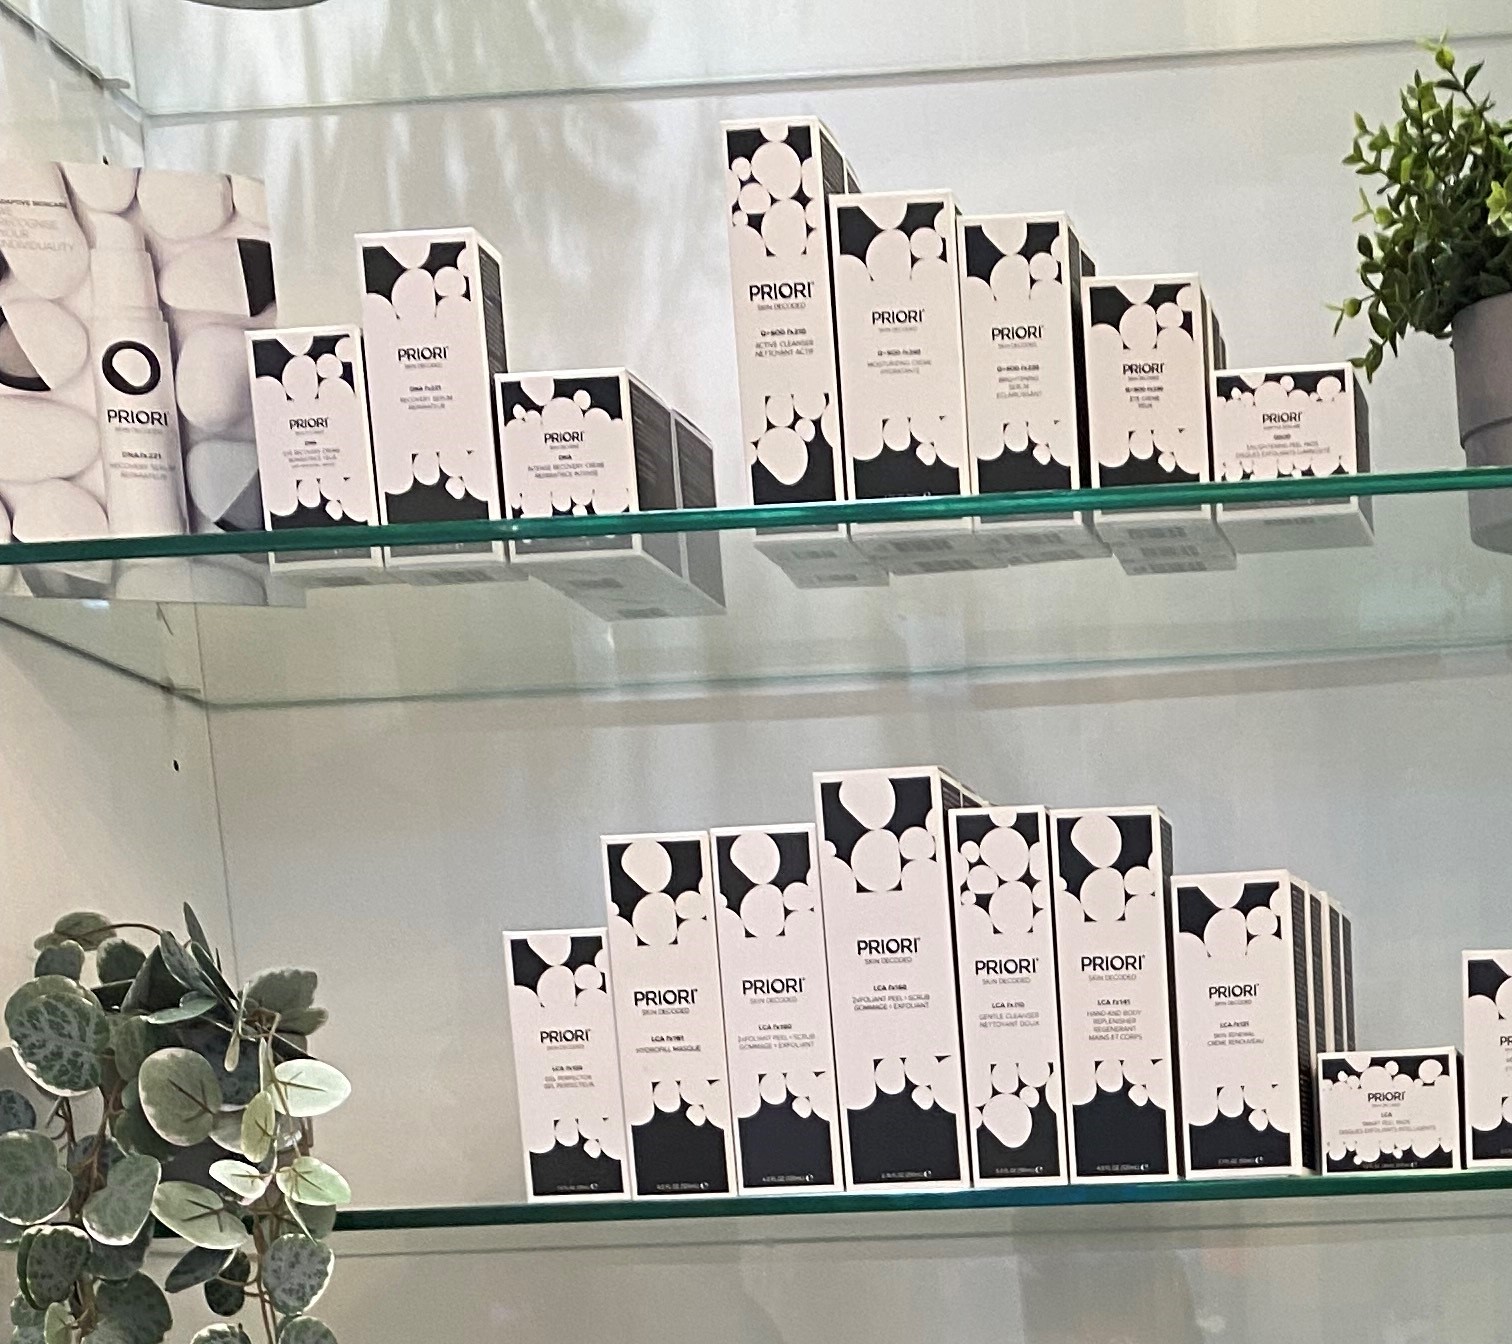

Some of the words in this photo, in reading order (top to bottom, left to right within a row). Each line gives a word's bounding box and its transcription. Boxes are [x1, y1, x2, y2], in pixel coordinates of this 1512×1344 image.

[749, 282, 812, 301] PRIORI
[872, 310, 923, 325] PRIORI
[992, 326, 1042, 340] PRIORI
[780, 339, 814, 347] CLEANSER
[398, 346, 448, 361] PRIORI
[1123, 363, 1164, 375] PRIORI
[107, 409, 168, 426] PRIORI
[289, 417, 329, 430] PRIORI
[1262, 412, 1301, 423] PRIORI
[544, 431, 584, 444] PRIORI
[857, 938, 919, 955] PRIORI
[975, 958, 1036, 975] PRIORI
[1081, 955, 1142, 972] PRIORI
[741, 978, 803, 995] PRIORI
[1208, 984, 1258, 999] PRIORI
[633, 989, 696, 1006] PRIORI
[1097, 998, 1111, 1006] LCA
[539, 1029, 589, 1043] PRIORI
[1120, 1033, 1143, 1041] CORPS
[1367, 1092, 1404, 1102] PRIORI
